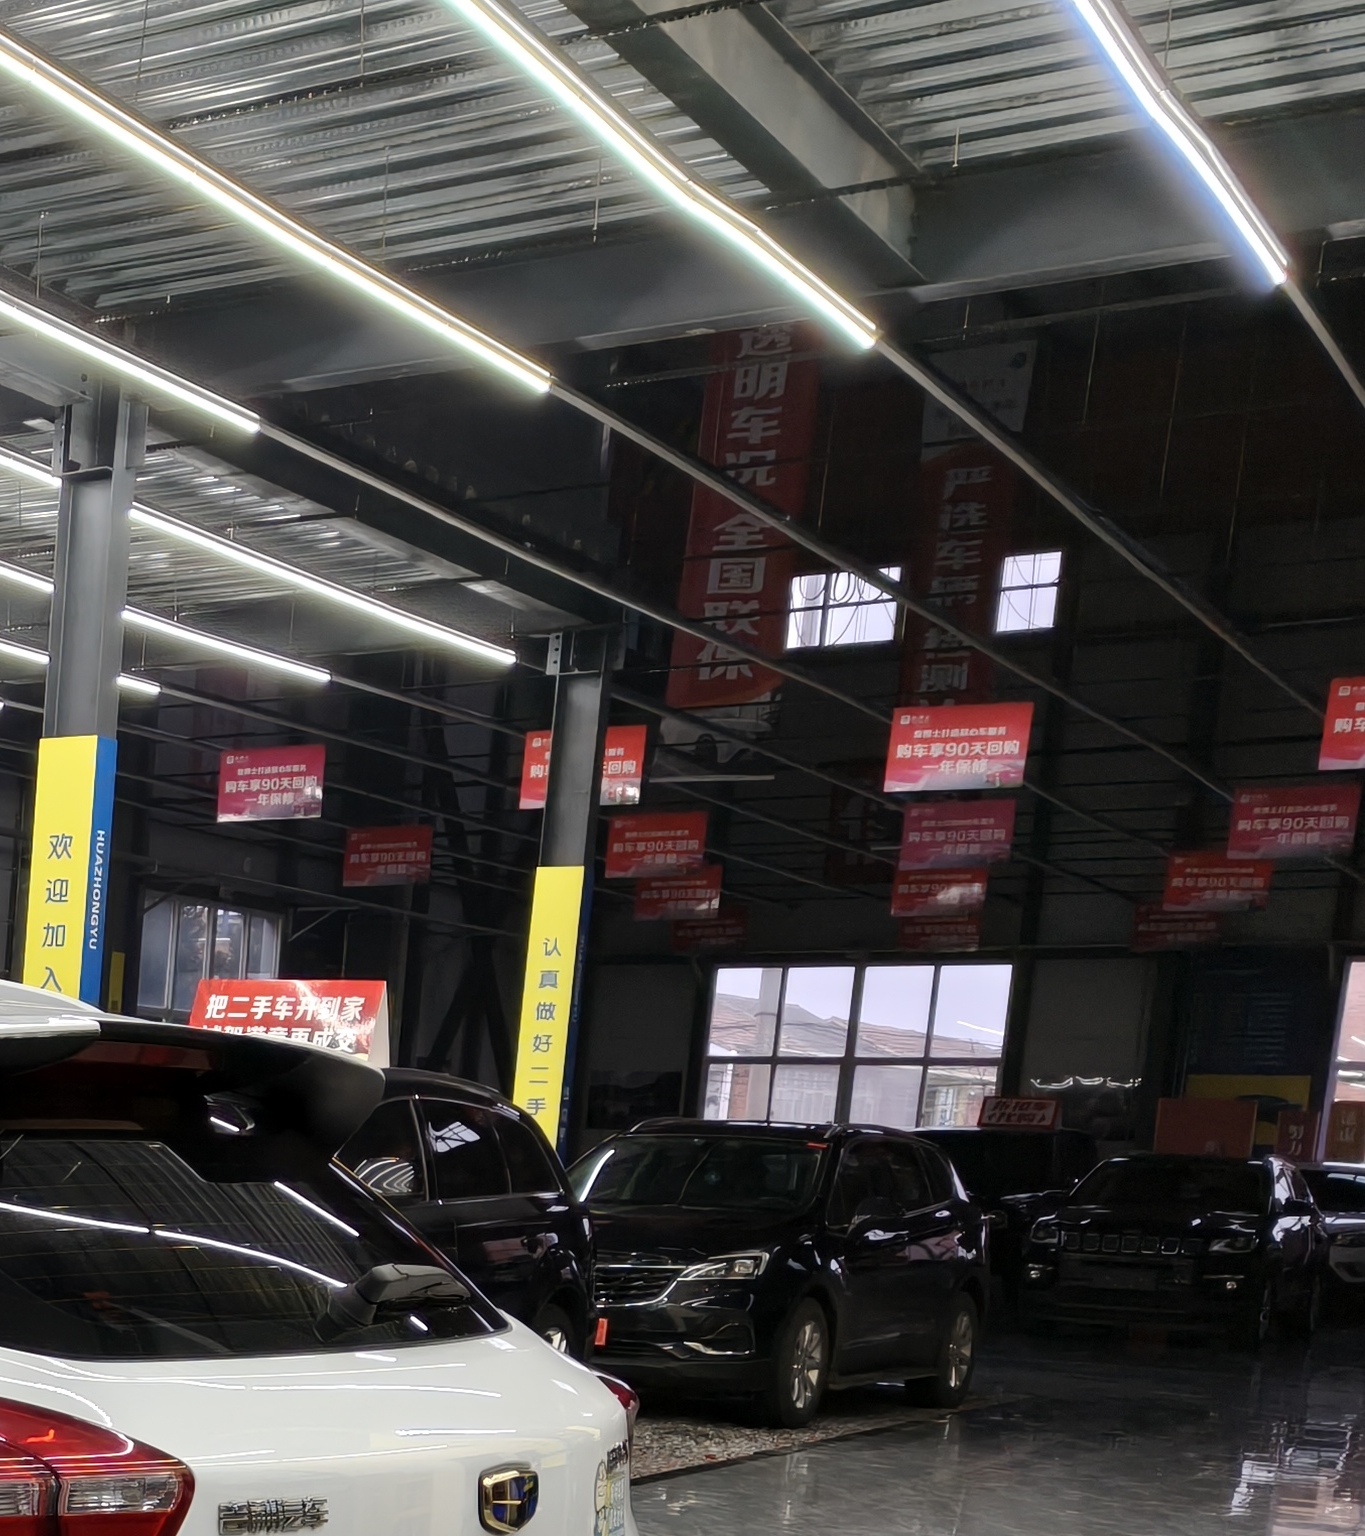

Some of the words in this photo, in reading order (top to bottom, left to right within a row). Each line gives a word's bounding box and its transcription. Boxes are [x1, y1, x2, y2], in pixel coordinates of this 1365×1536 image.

[224, 776, 318, 793] 购车享90天回购
[896, 740, 1020, 758] 购车享90天回购
[40, 832, 73, 993] 欢迎加入
[88, 829, 106, 950] HUAZHONGYU
[204, 993, 366, 1022] 把二手车开到家
[525, 937, 562, 1116] 认真做好二手
